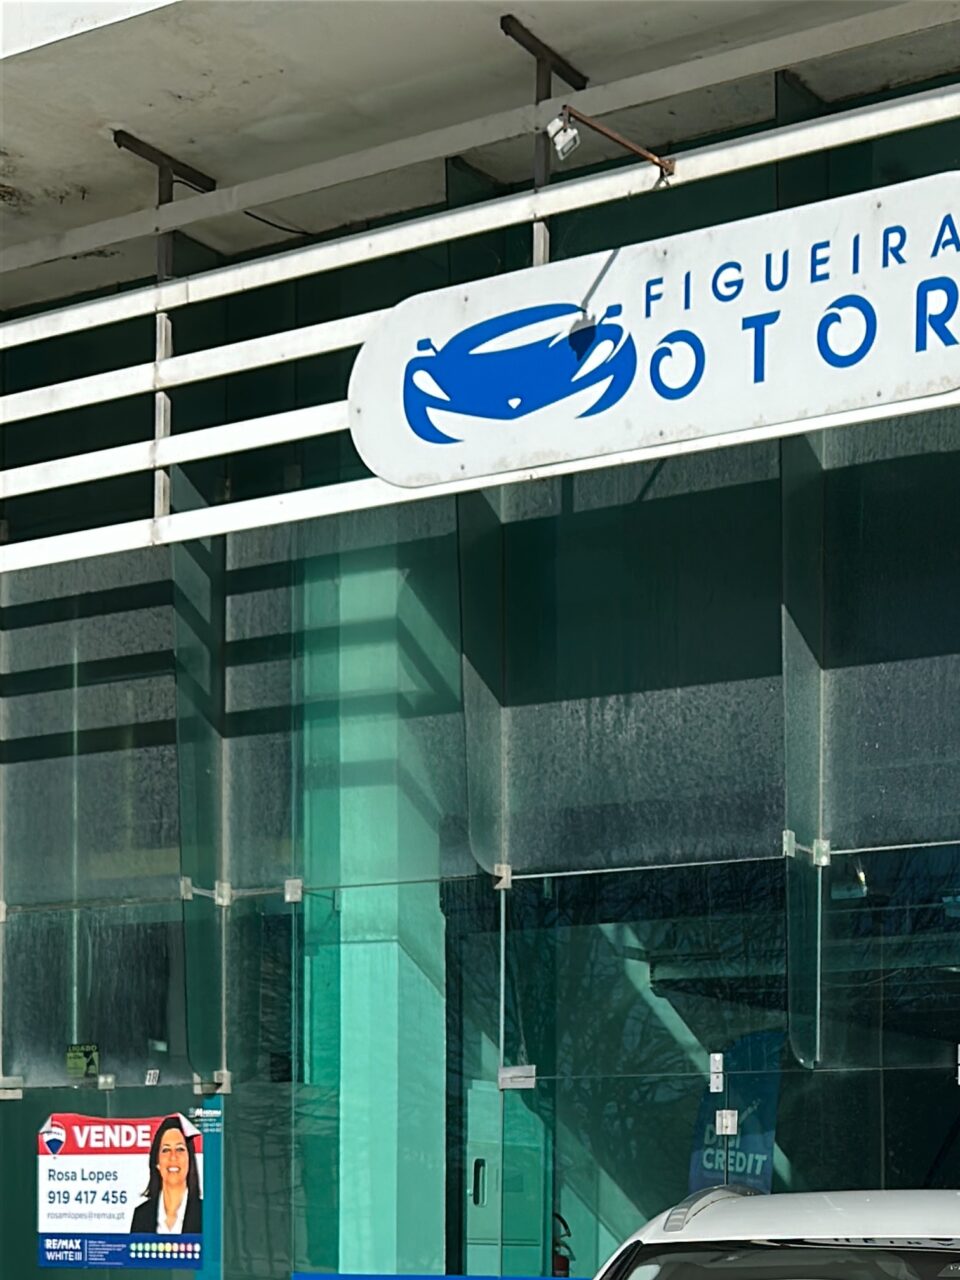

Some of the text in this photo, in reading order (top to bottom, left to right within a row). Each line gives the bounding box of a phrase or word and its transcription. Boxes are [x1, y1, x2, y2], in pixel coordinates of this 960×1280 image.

[72, 1125, 151, 1149] VENDE
[702, 1147, 767, 1176] CREDIT
[48, 1168, 118, 1184] Rosa Lopes
[48, 1190, 128, 1204] 919 417 456
[45, 1239, 82, 1250] RE/MAX
